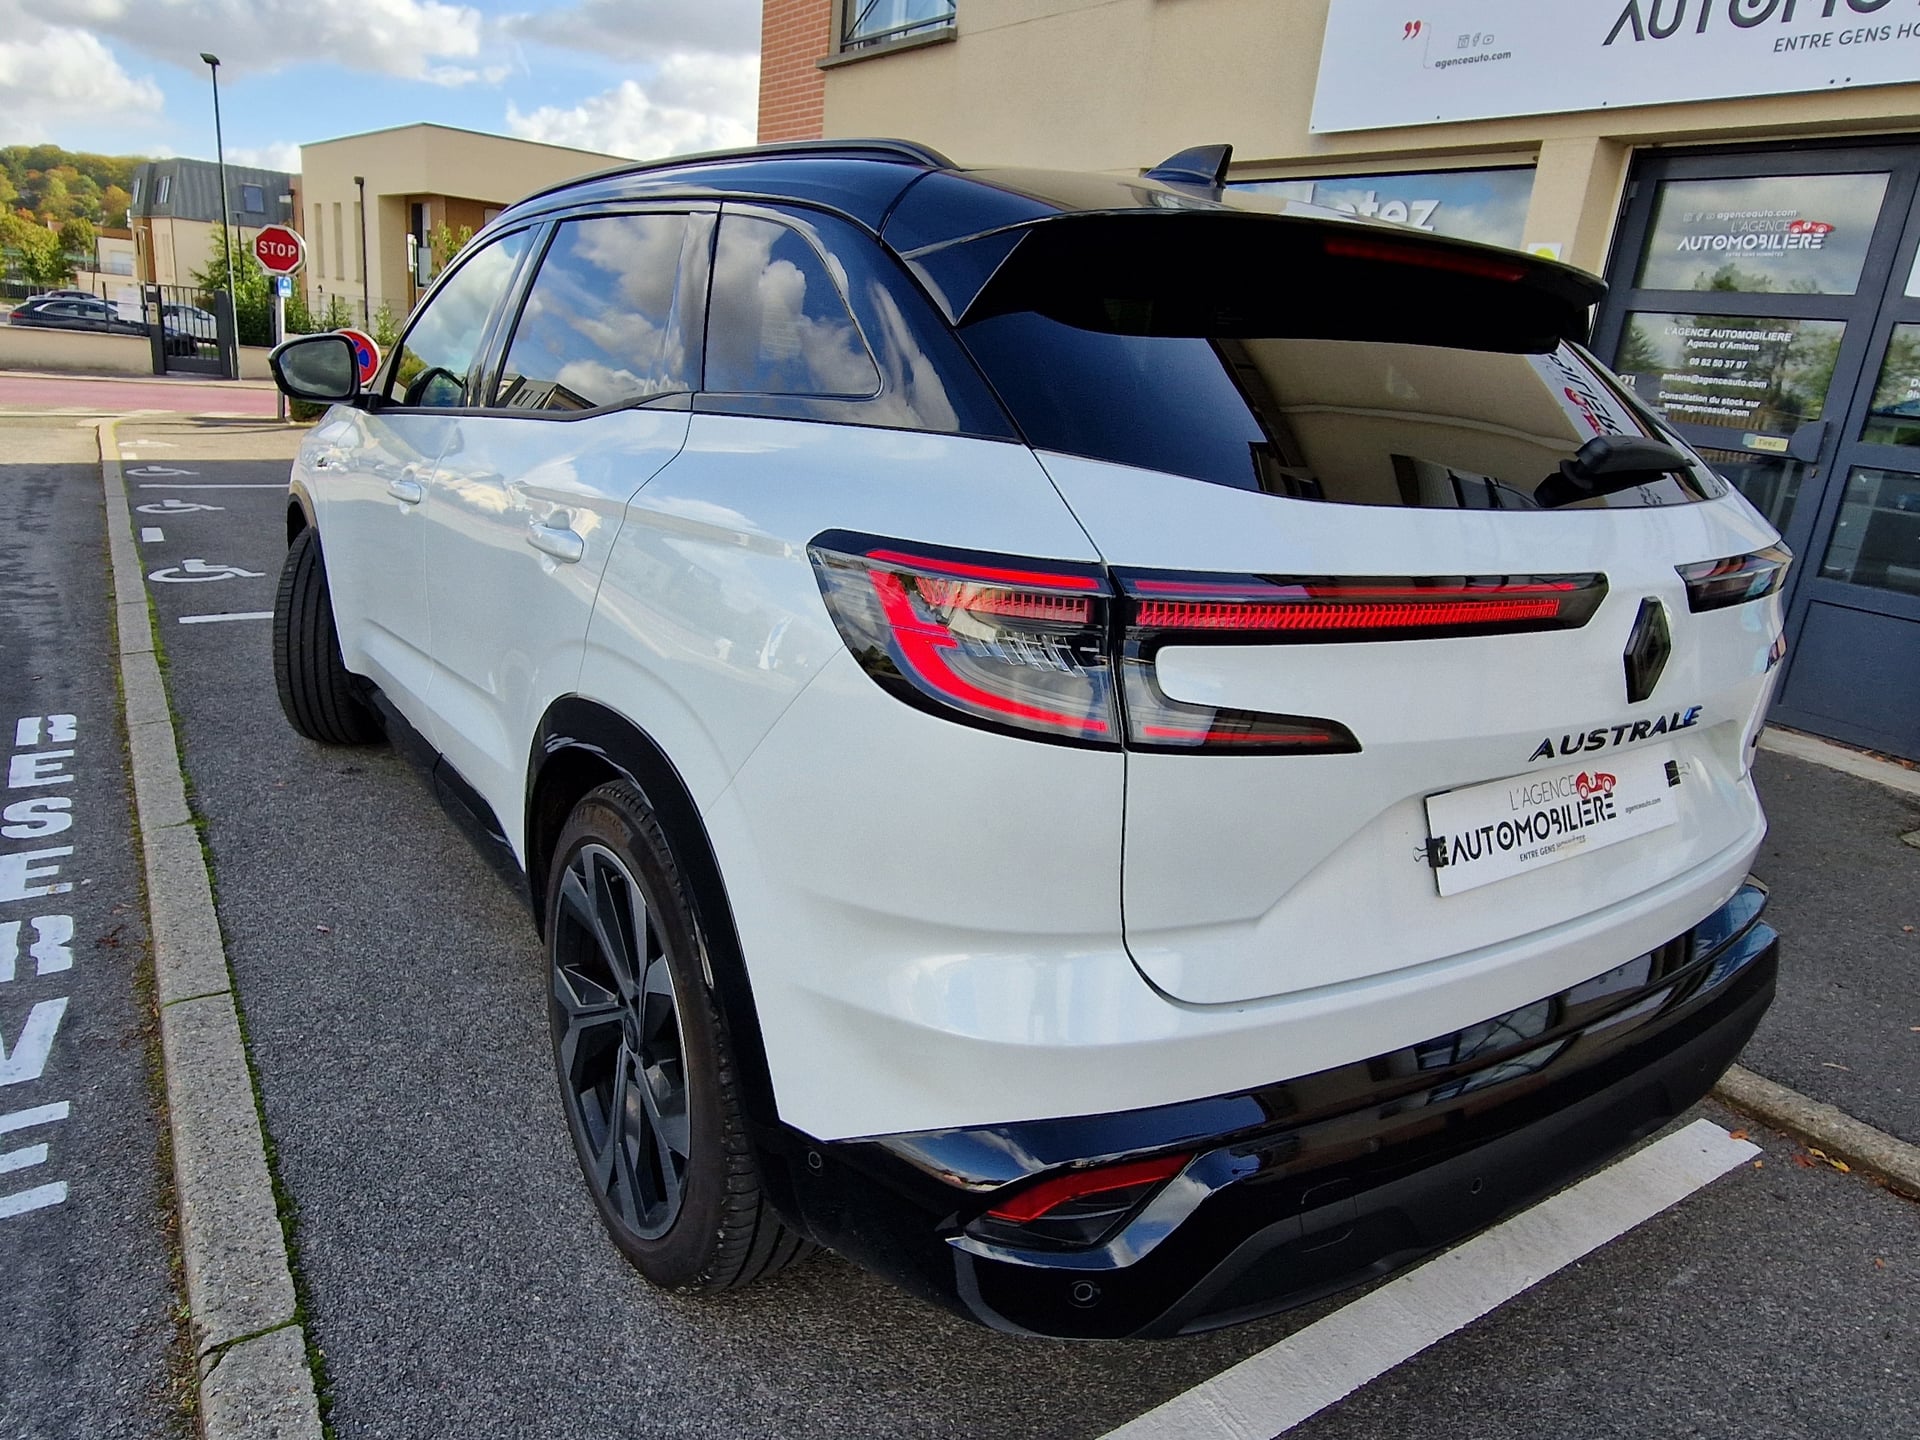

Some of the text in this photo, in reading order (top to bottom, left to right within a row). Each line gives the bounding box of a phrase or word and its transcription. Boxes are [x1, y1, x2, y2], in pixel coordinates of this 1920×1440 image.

[1602, 0, 1891, 46] AUTO
[1773, 31, 1834, 52] ENTRE
[1839, 25, 1892, 45] GENS
[1435, 51, 1512, 69] agenceauto.com
[1716, 208, 1798, 221] agenceauto.com
[1730, 219, 1793, 234] L'AGENCE
[259, 240, 297, 258] STOP
[1676, 232, 1826, 251] AUTOMOBILIERE
[1664, 326, 1793, 343] L'AGENCE AUTOMOBILIERE
[1687, 338, 1761, 352] Agence d'Amiens
[1662, 372, 1768, 389] amiens@agenceauto.com
[1659, 391, 1760, 408] Consultation du stock sur
[1664, 402, 1750, 417] www.agenceauto.com
[1509, 774, 1578, 811] L'AGENCE
[1451, 792, 1617, 866] AUTOMOBILIERE
[1519, 848, 1540, 862] ENTRE
